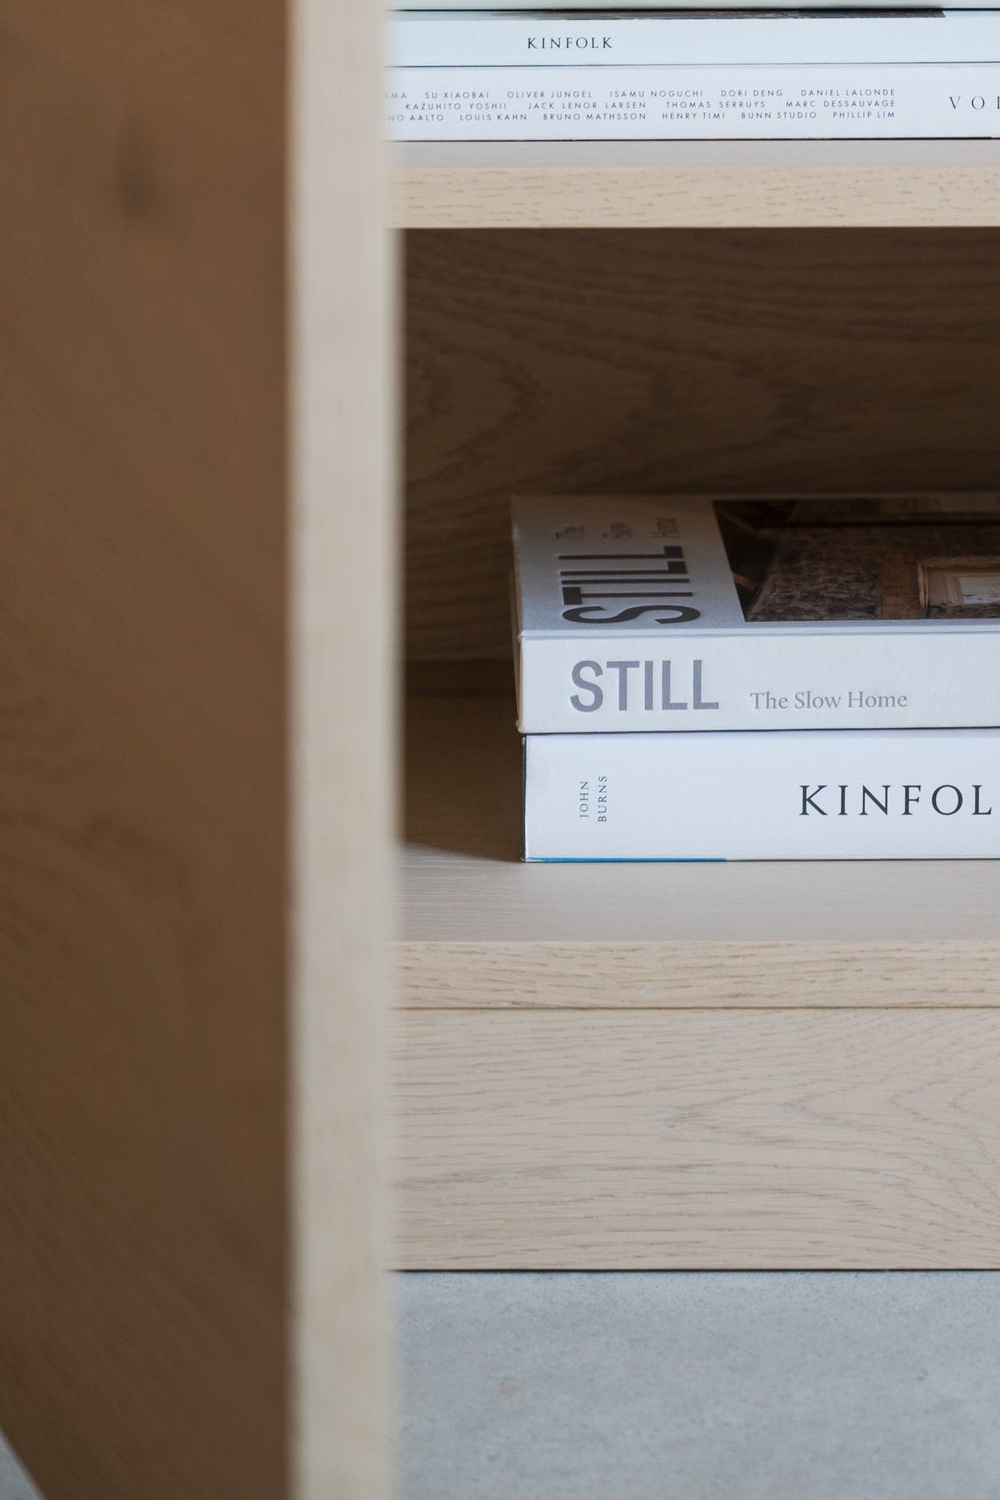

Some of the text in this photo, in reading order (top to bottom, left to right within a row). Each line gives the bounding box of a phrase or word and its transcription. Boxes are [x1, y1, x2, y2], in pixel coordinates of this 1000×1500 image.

[527, 36, 613, 49] KINFOLK
[424, 91, 438, 100] SU
[443, 91, 489, 100] XIAOBAI
[506, 90, 545, 99] OLIVER
[550, 90, 593, 99] JUNGEL
[609, 90, 645, 98] ISAMU
[650, 90, 703, 98] NOGUCHI
[720, 89, 748, 98] DORI
[752, 89, 783, 98] DENG
[800, 88, 840, 97] DANIEL
[845, 88, 895, 97] LALONDE
[405, 99, 895, 111] KAZUHITO YOSHII JACK LENOR LARSEN THOMAS SERRUYS MARC DESSAUVAGE
[409, 113, 444, 122] AALTO
[459, 113, 492, 122] LOUIS
[496, 113, 527, 121] KAHN
[542, 113, 581, 121] BRUNO
[585, 112, 646, 121] MATHSSON
[662, 112, 697, 120] HENRY
[702, 111, 725, 120] TIMI
[741, 111, 772, 120] BUNN
[776, 111, 817, 120] STUDIO
[832, 110, 872, 119] PHILLIP
[877, 111, 895, 119] LIM
[557, 545, 702, 624] STILL
[570, 660, 719, 712] STILL
[750, 690, 907, 710] The Slow Home
[579, 781, 590, 818] JOHN
[597, 775, 608, 823] BURNS
